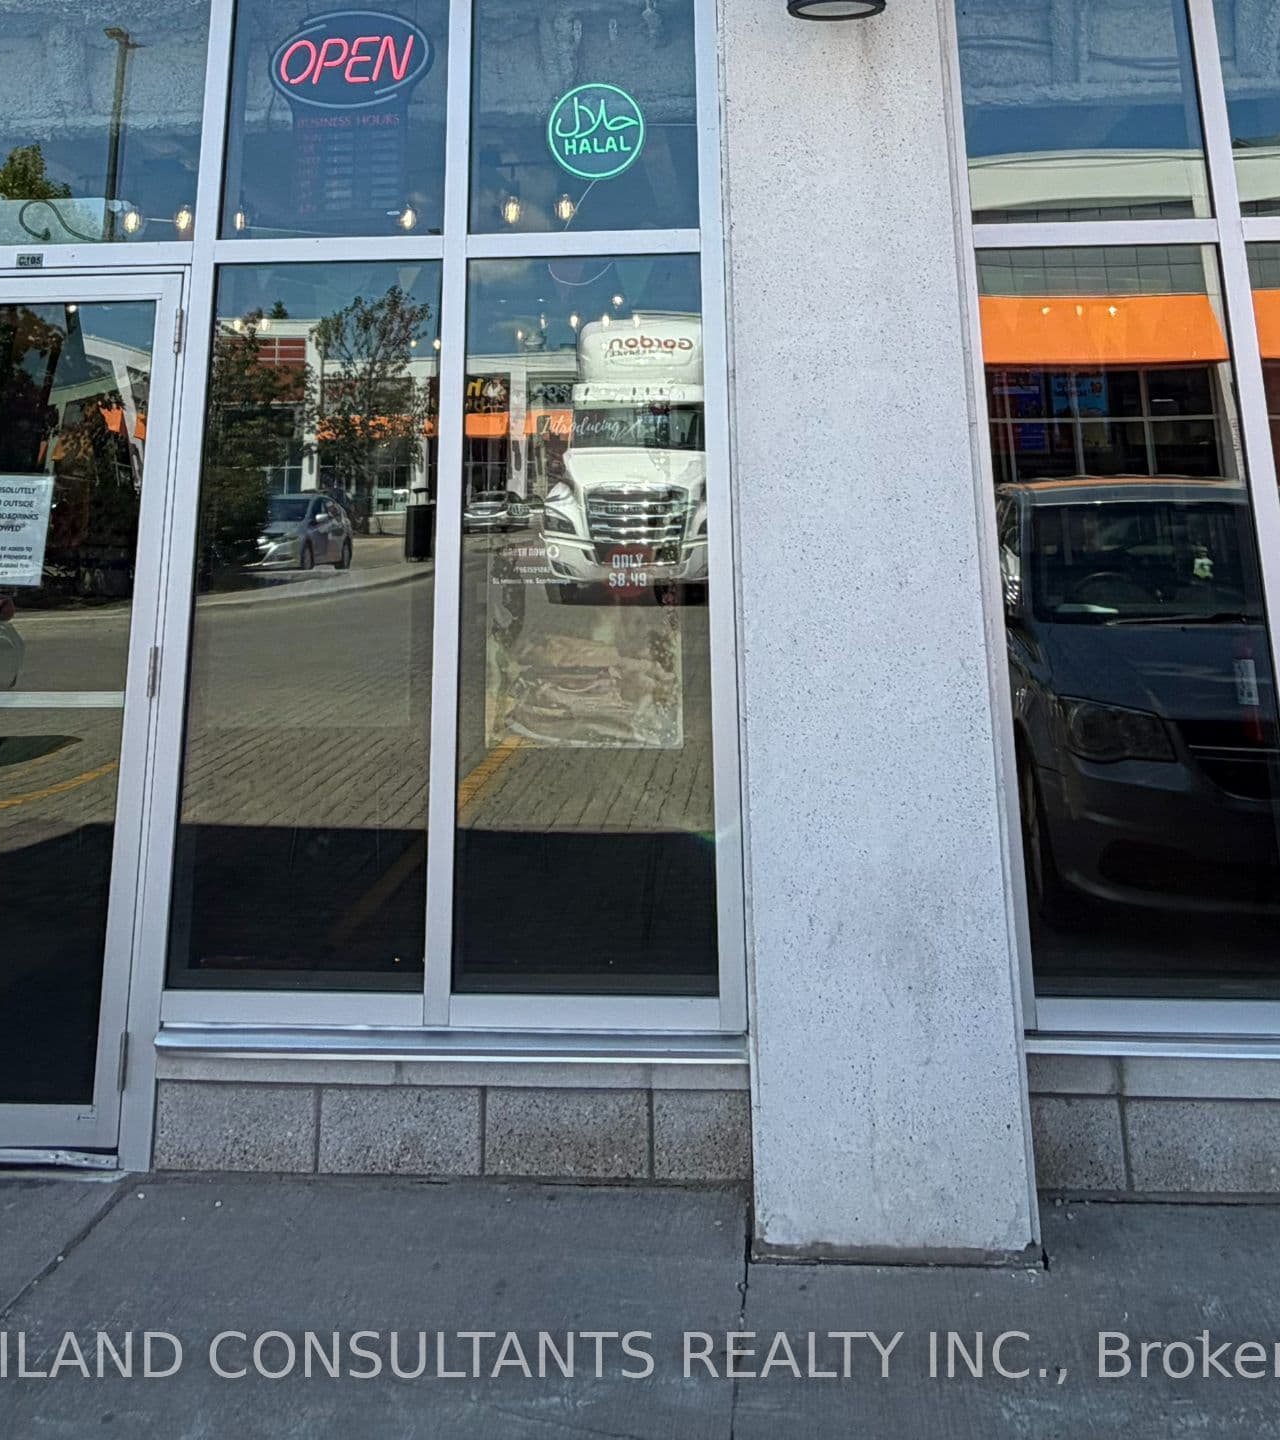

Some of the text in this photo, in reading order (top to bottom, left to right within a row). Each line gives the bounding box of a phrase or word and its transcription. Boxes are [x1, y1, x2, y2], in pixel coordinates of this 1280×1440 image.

[280, 34, 415, 85] OPEN
[555, 96, 638, 139] حلال
[564, 134, 631, 155] HALAL
[3, 500, 35, 508] OUTSIDE
[612, 554, 644, 569] ONLY
[608, 572, 648, 587] $8.49
